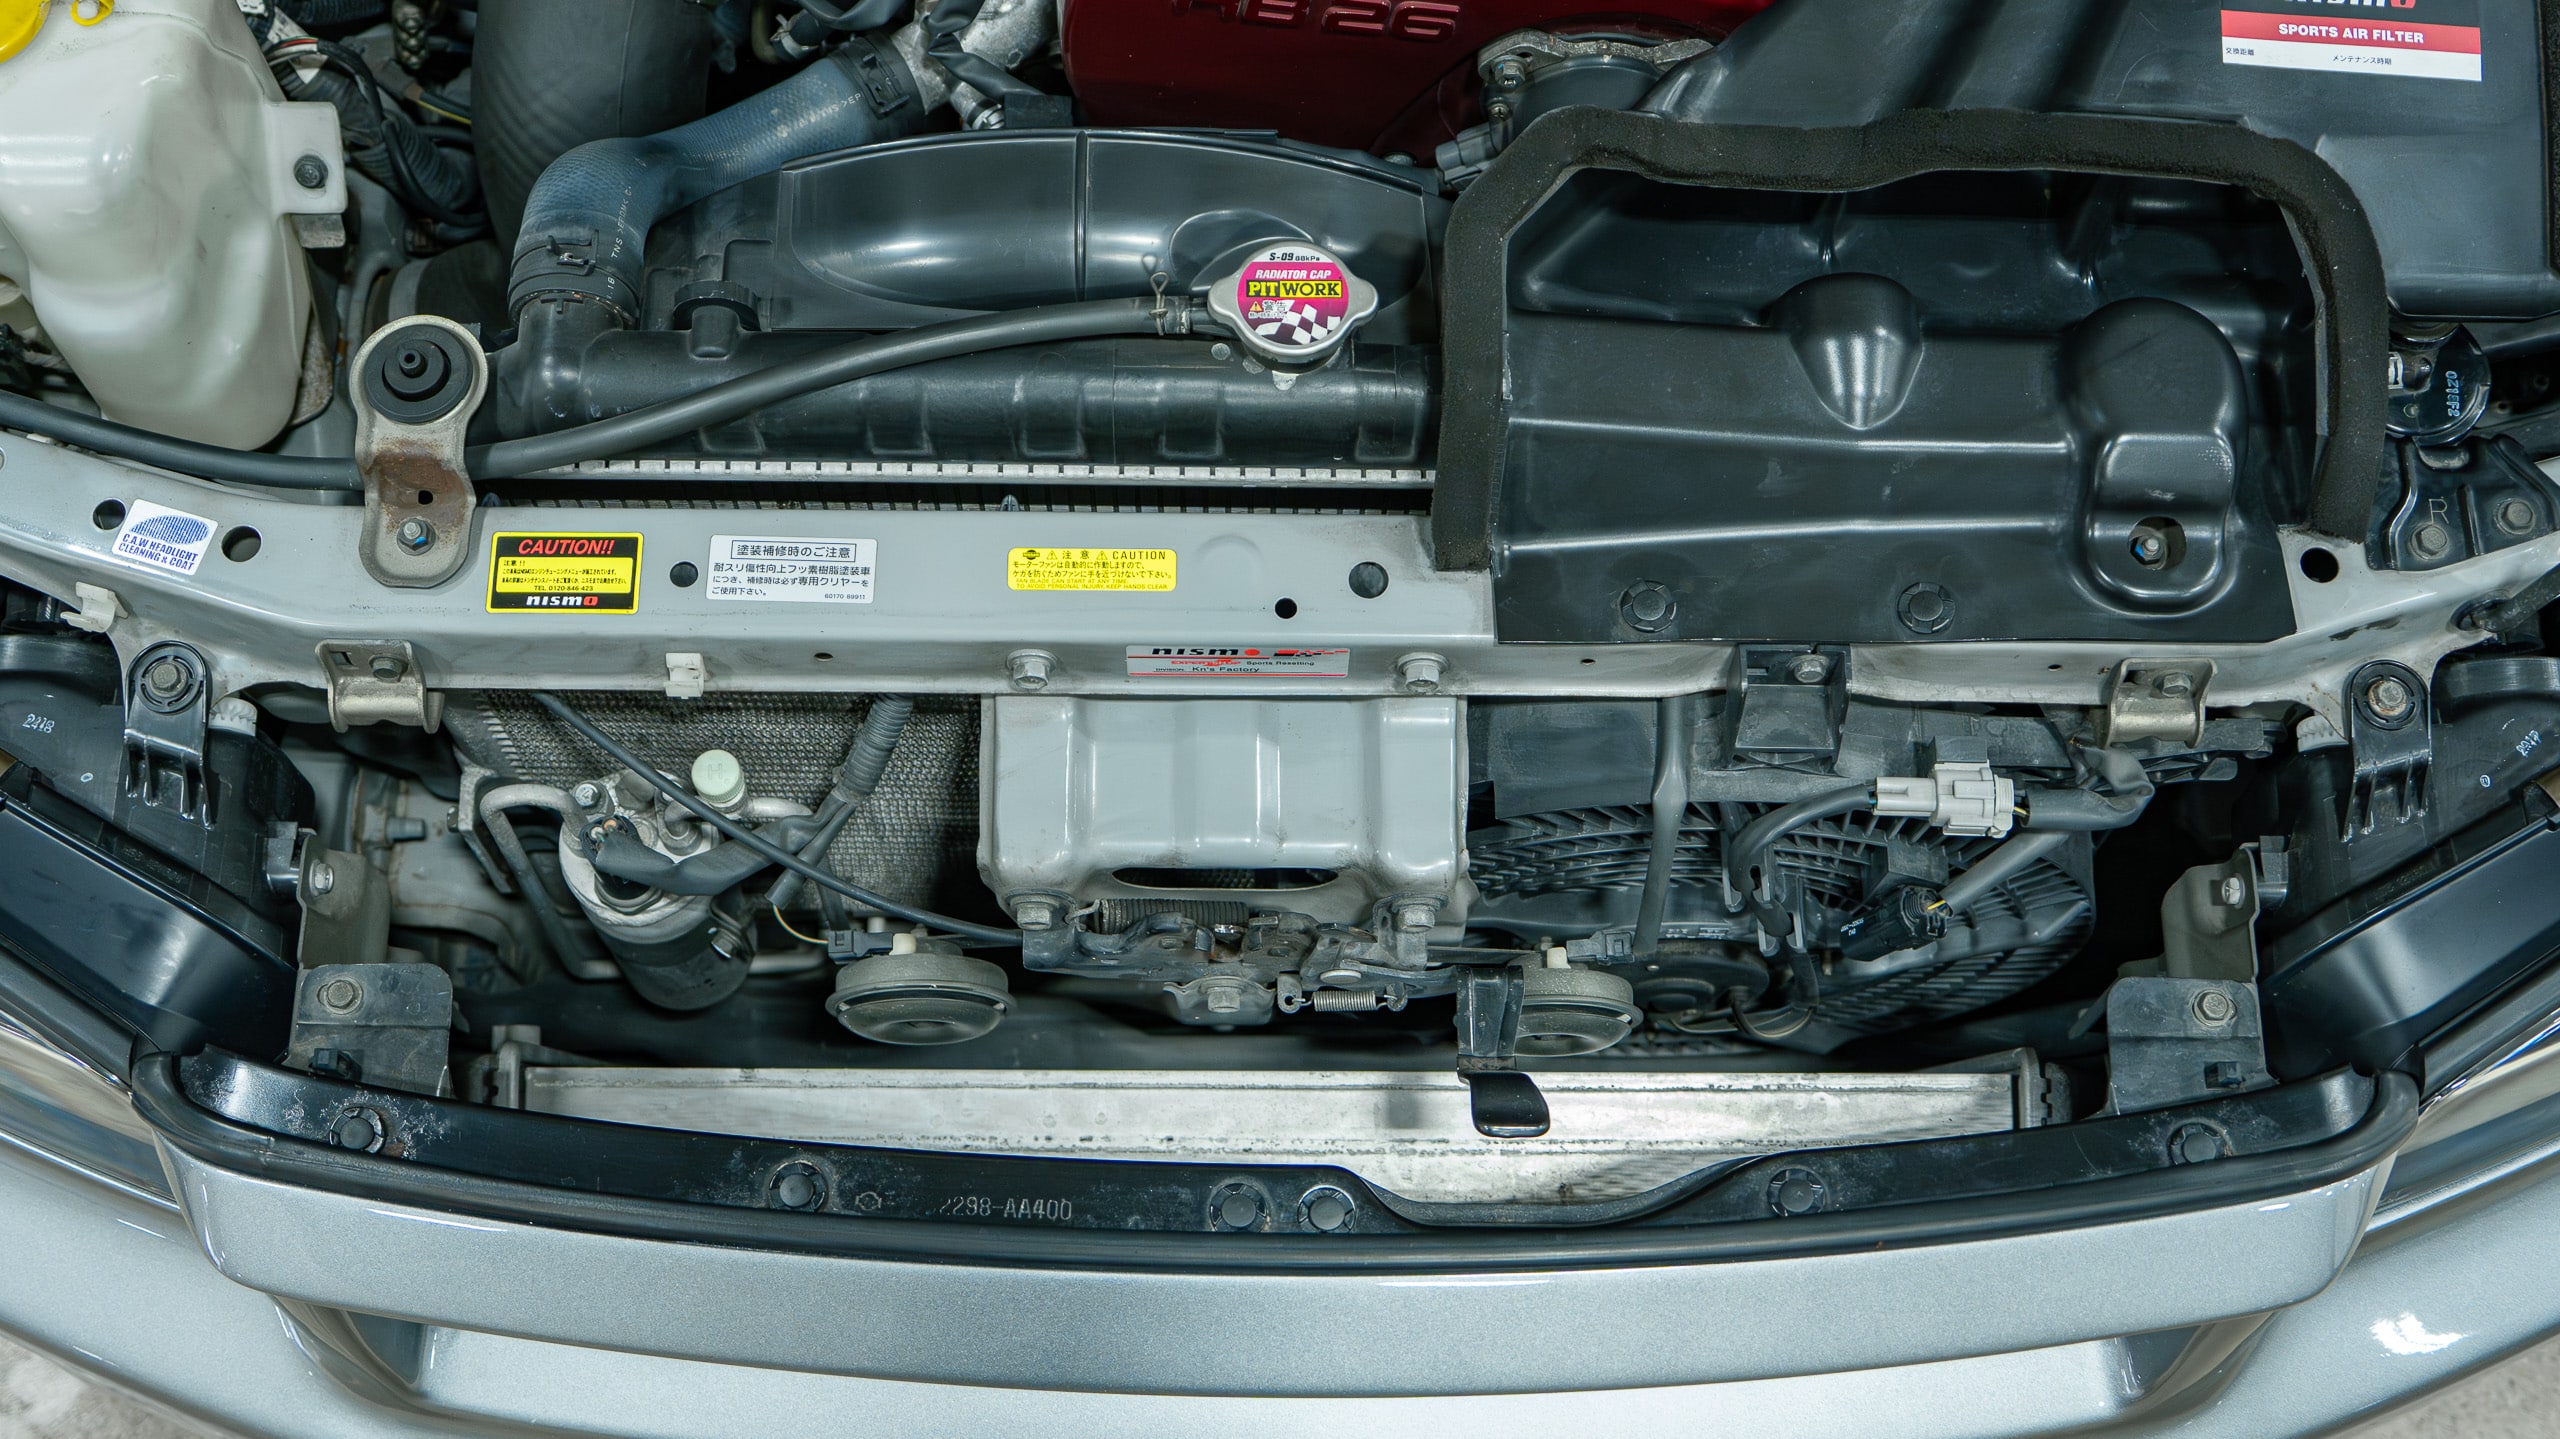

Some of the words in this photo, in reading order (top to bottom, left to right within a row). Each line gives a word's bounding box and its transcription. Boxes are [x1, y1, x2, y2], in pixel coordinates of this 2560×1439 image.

[2278, 23, 2339, 38] SPORTS
[2343, 28, 2369, 40] AIR
[2373, 30, 2424, 44] FILTER
[1269, 252, 1294, 261] S-09
[1255, 269, 1308, 279] RADIATOR
[1309, 269, 1332, 279] CAP
[2428, 497, 2450, 525] R
[149, 541, 199, 562] HEADLIGHT
[518, 539, 616, 555] CAUTION!!
[736, 544, 851, 559] 塗装補修時のご注意
[118, 543, 161, 562] CLEANING
[169, 557, 195, 571] COAT
[1112, 550, 1166, 560] CAUTION
[711, 586, 767, 597] ご使用下さい。
[526, 595, 599, 607] nismo
[1219, 666, 1260, 674] Factory
